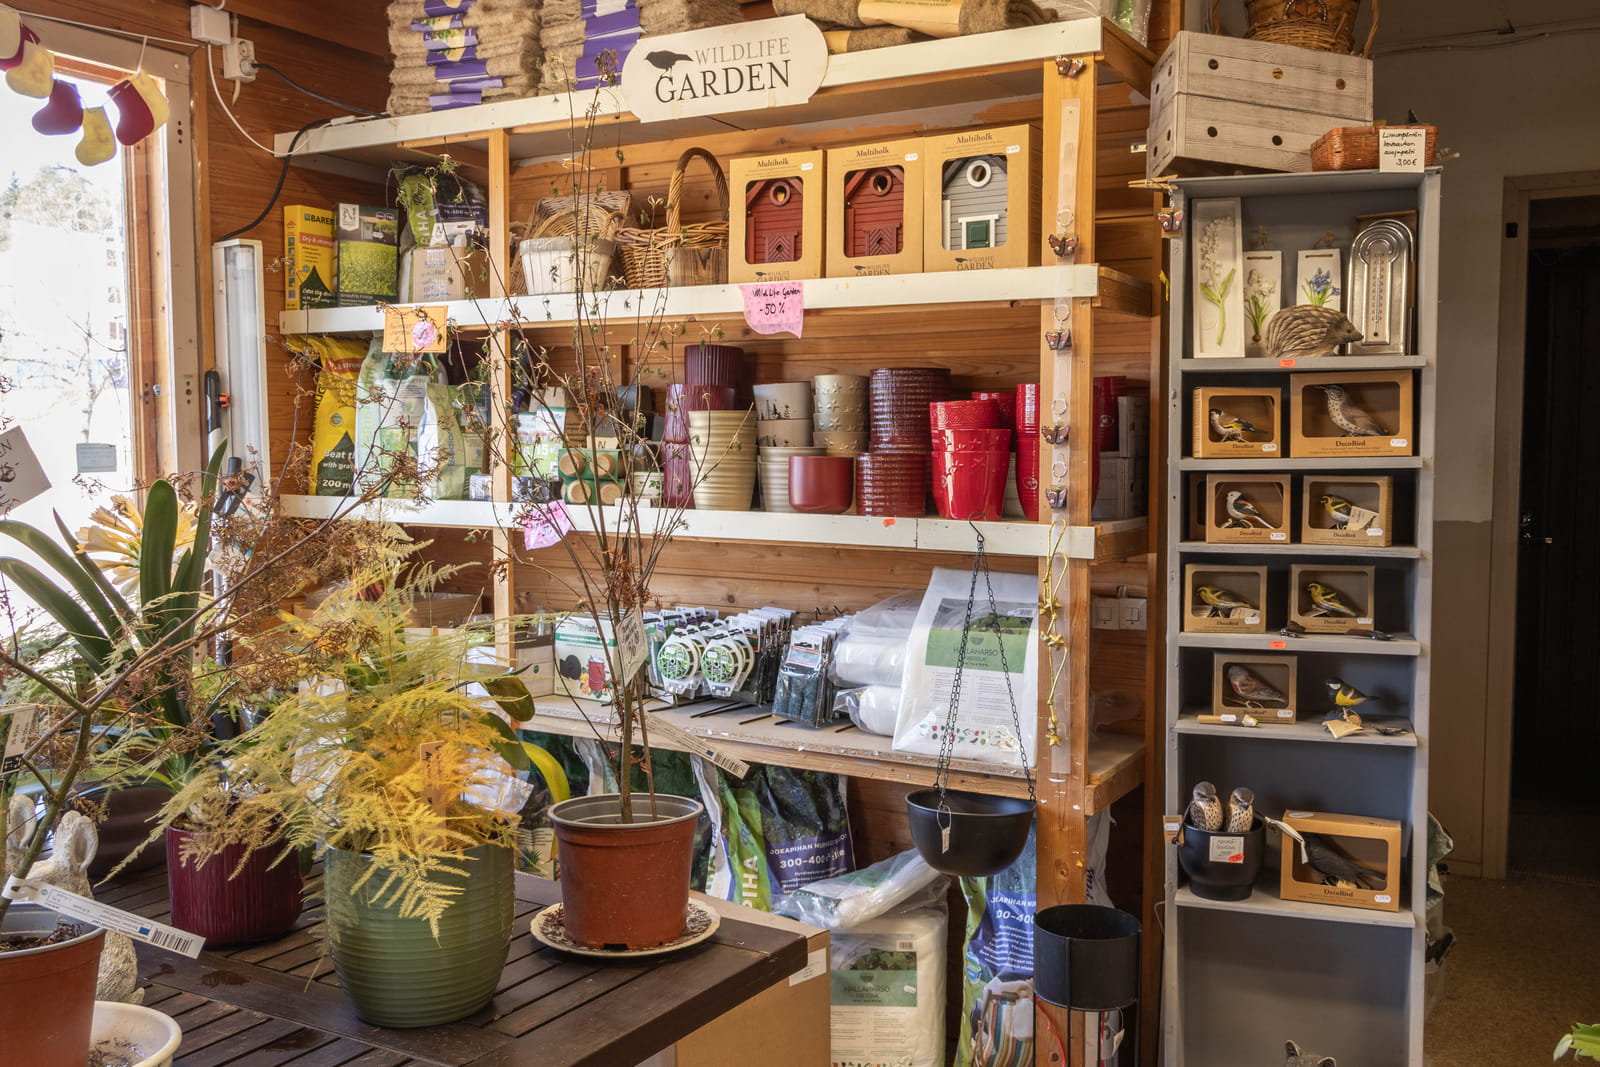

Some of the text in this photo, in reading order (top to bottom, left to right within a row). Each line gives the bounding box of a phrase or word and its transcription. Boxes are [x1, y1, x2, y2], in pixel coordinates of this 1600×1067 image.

[694, 37, 791, 65] WILDLIFE
[655, 59, 791, 103] GARDEN
[956, 133, 993, 144] Multiholk
[856, 146, 889, 157] Multiholk
[757, 158, 789, 168] Multiholk
[415, 210, 431, 246] PIHA
[956, 262, 994, 271] GARDEN
[324, 449, 342, 459] Beat
[323, 479, 341, 488] 200
